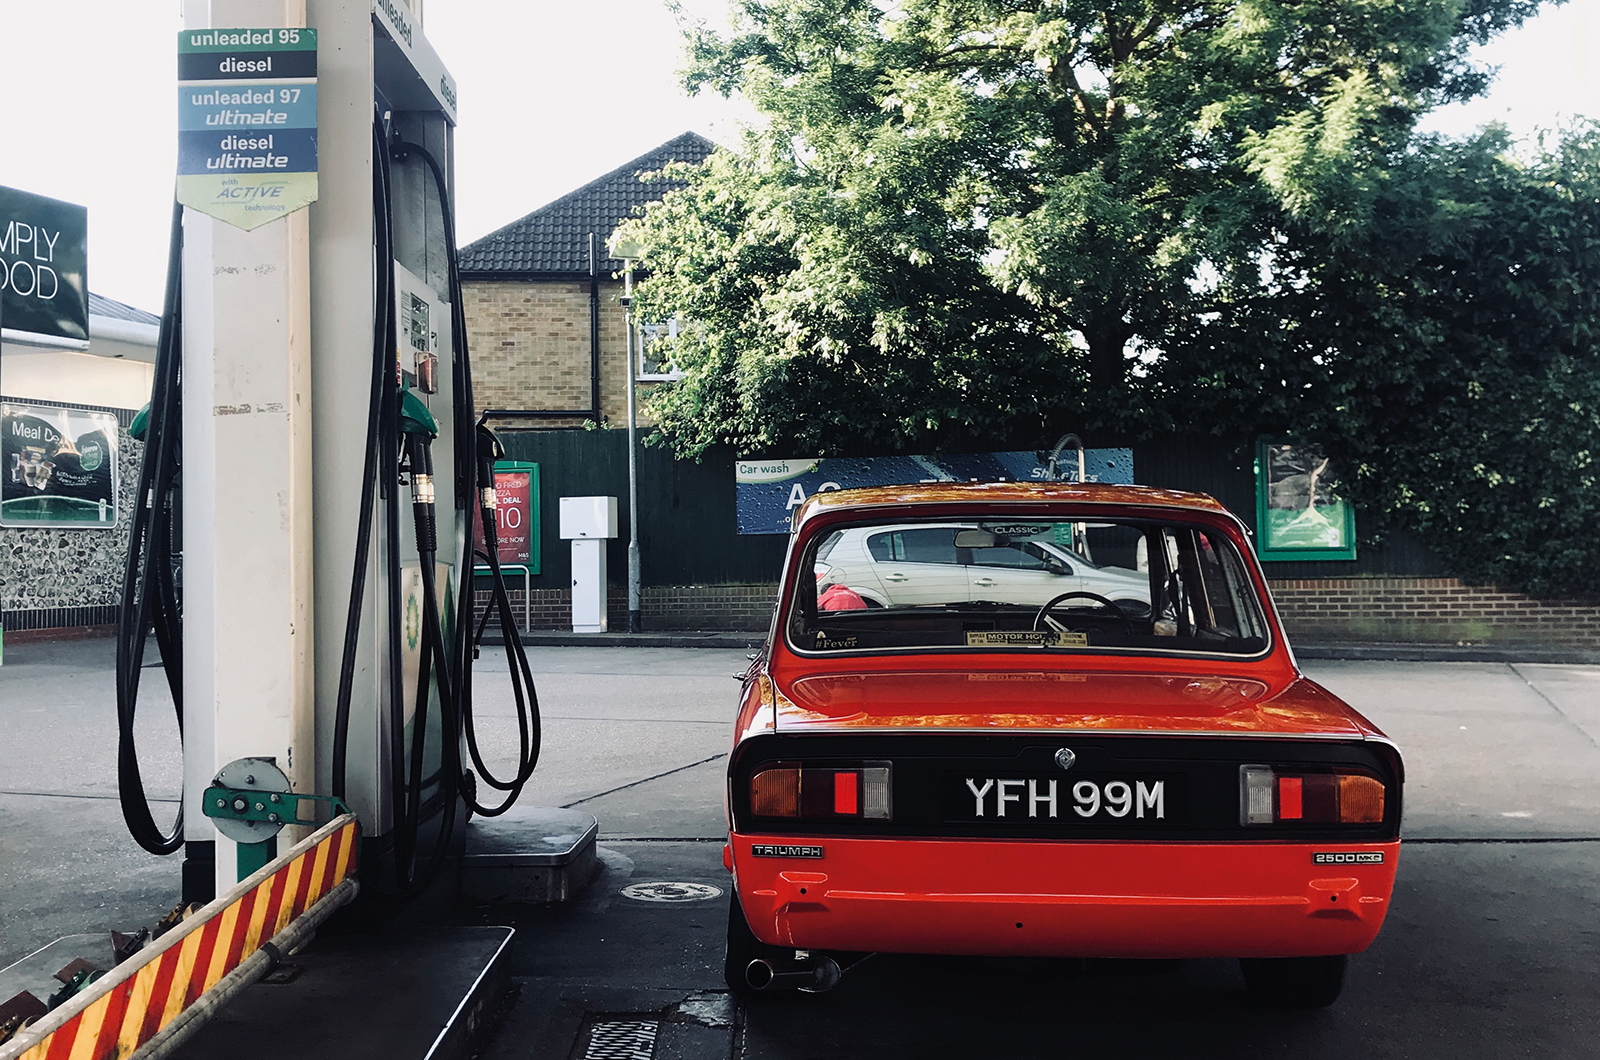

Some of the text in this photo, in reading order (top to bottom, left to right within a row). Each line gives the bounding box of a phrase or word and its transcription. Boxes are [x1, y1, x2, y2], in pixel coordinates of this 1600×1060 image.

[191, 29, 301, 46] unleaded 95
[219, 57, 272, 73] diesel
[191, 89, 301, 106] unleaded 97
[205, 109, 288, 125] ultimate
[220, 134, 274, 150] diesel
[206, 153, 289, 169] ultimate
[221, 178, 239, 186] with
[216, 187, 285, 199] ACTIVE
[245, 204, 286, 212] technology
[0, 221, 60, 262] MPLY
[12, 421, 41, 440] Meal
[739, 463, 790, 475] Car wash
[966, 778, 1165, 819] YFH 99M
[754, 846, 820, 856] TRIUMPH
[1316, 854, 1356, 862] 2500
